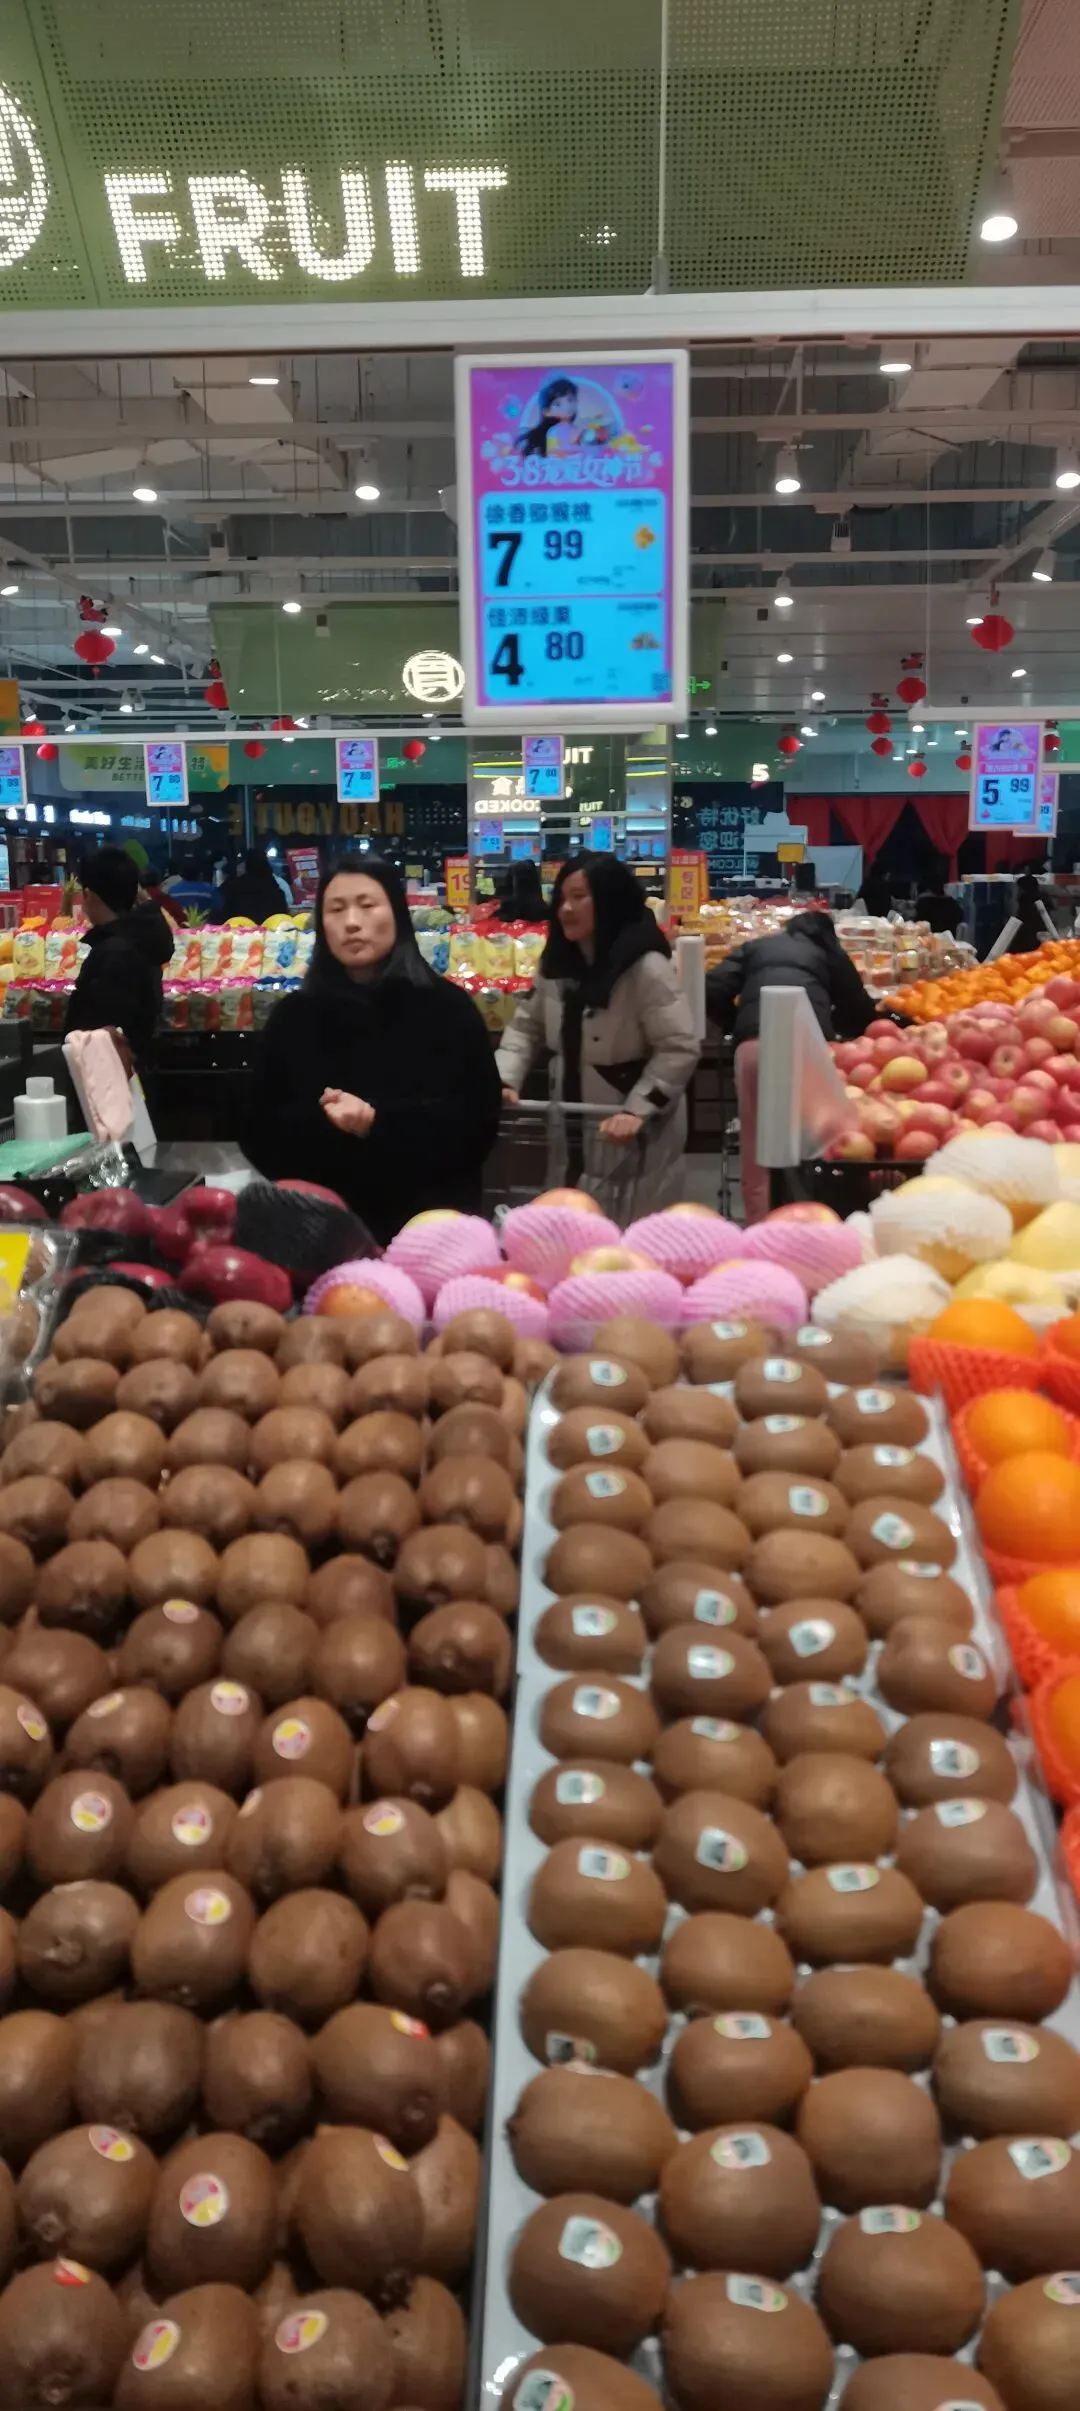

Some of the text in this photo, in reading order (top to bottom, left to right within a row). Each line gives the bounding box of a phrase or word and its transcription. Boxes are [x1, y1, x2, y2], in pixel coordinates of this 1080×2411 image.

[104, 159, 508, 281] FRUIT
[489, 530, 584, 588] 7 99
[490, 633, 525, 686] 4
[545, 631, 585, 660] 80
[152, 776, 163, 792] 7
[343, 772, 354, 788] 7
[529, 768, 540, 785] 7
[982, 778, 1030, 806] 5 99
